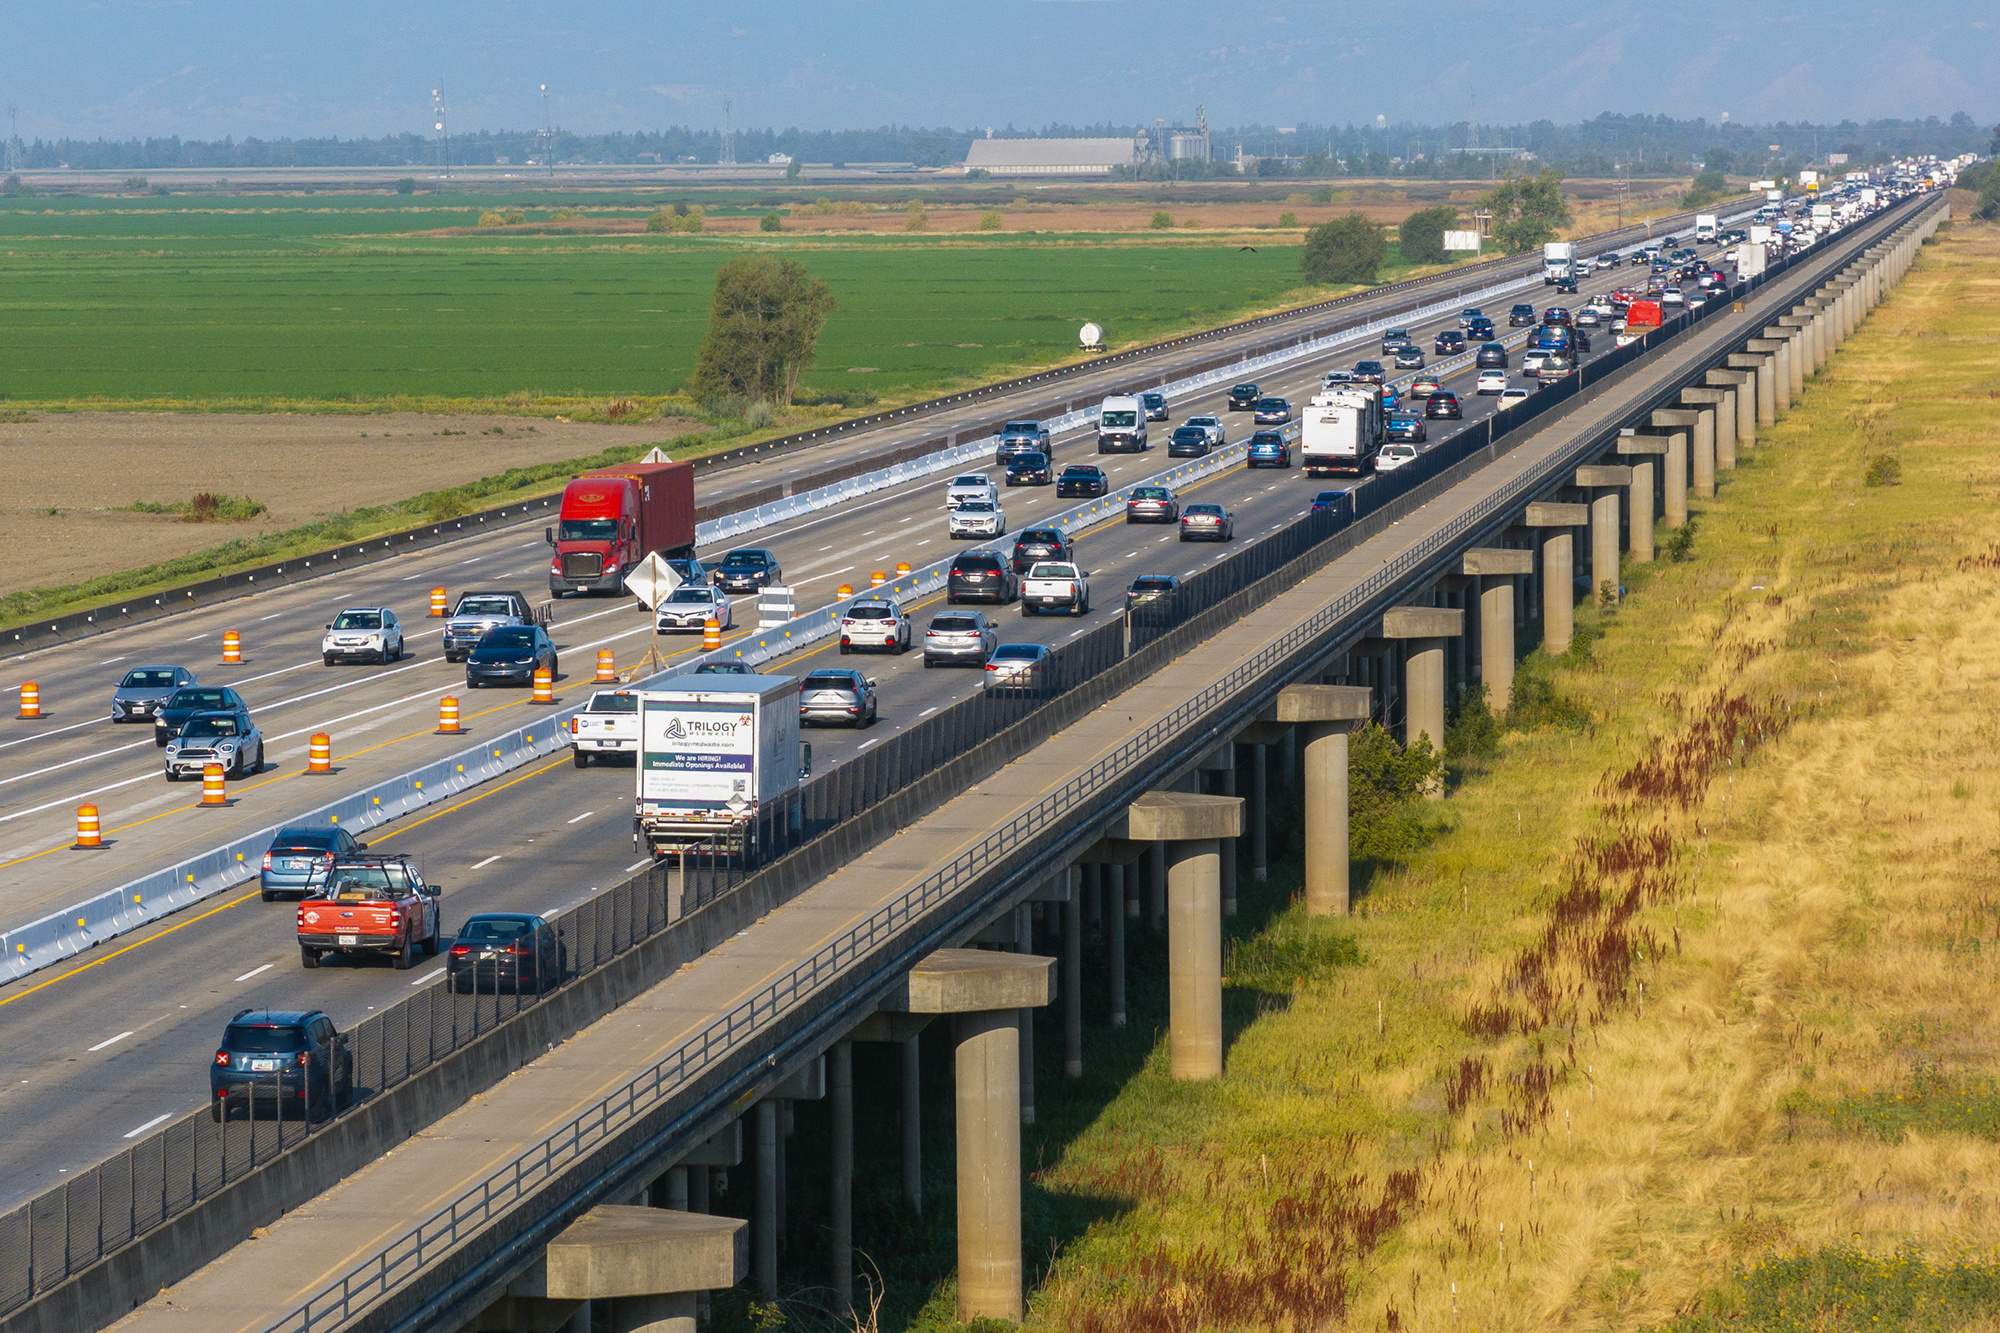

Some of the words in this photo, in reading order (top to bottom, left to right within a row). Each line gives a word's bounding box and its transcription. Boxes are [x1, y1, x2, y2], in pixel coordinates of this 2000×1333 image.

[687, 721, 738, 731] TRILOGY
[685, 761, 714, 770] Openings
[715, 762, 745, 770] Available!
